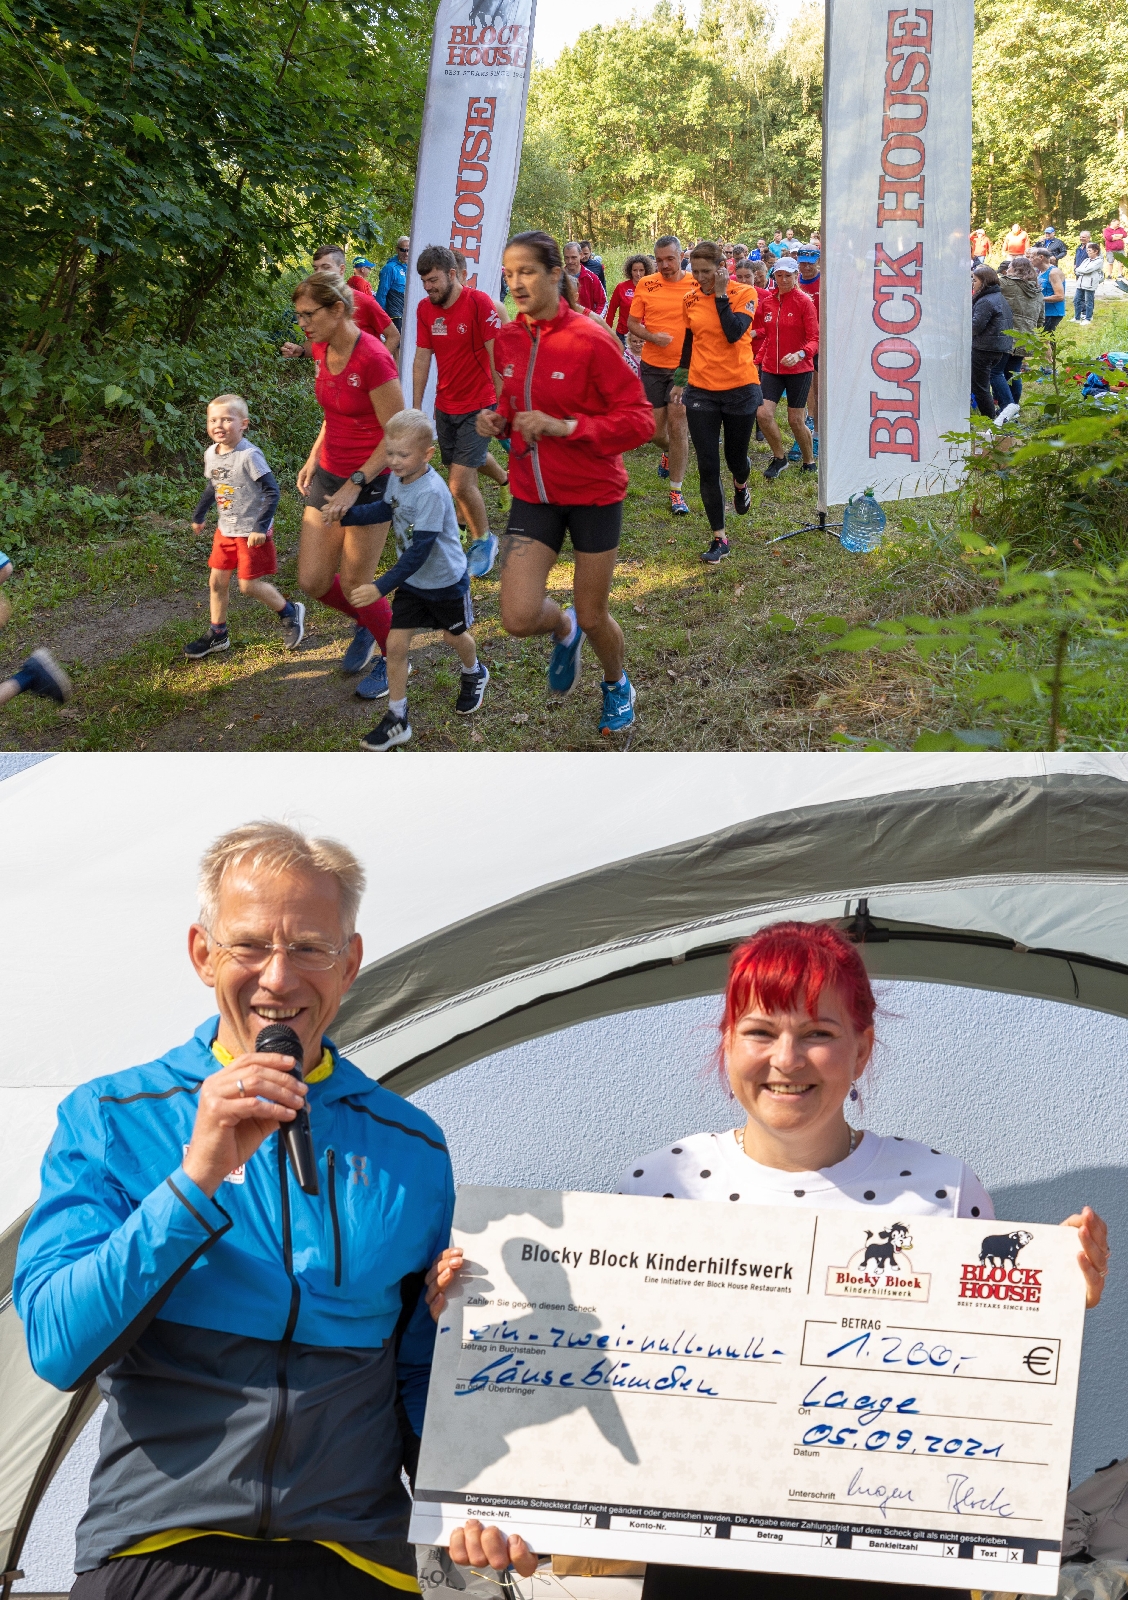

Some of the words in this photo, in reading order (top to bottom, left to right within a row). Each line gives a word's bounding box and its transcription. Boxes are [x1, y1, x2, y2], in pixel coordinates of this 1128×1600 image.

[448, 24, 529, 47] BLOCK
[446, 46, 527, 69] HOUSE
[876, 8, 933, 229] HOUSE
[450, 96, 497, 264] HOUSE
[868, 242, 924, 463] BLOCK
[521, 1244, 583, 1268] Blocky
[589, 1248, 639, 1269] Block
[646, 1252, 793, 1280] Kinderhilfswerk
[960, 1263, 1043, 1286] BLOCK
[644, 1275, 659, 1284] Eine
[660, 1277, 692, 1287] Initiative
[693, 1279, 705, 1288] der
[706, 1280, 726, 1289] Block
[727, 1282, 749, 1291] House
[750, 1283, 792, 1294] Restaurants
[844, 1286, 912, 1297] Kinderhilfswerk
[958, 1281, 1042, 1303] HOUSE
[467, 1296, 494, 1306] Zahlen
[496, 1298, 510, 1308] Sie
[511, 1300, 536, 1310] gegen
[538, 1302, 566, 1312] diesen
[567, 1303, 598, 1314] Scheck
[975, 1302, 1001, 1310] STEAKS
[841, 1317, 882, 1331] BETRAG
[460, 1341, 488, 1354] Betrag
[489, 1343, 497, 1353] in
[499, 1344, 547, 1356] Buchstaben
[1022, 1346, 1054, 1376] €
[455, 1382, 466, 1390] an
[488, 1382, 536, 1396] Überbringer
[797, 1406, 812, 1416] Ort
[793, 1447, 821, 1458] Datum
[788, 1488, 837, 1501] Unterschrift
[465, 1494, 480, 1504] Der
[480, 1496, 529, 1507] vorgedruckte
[530, 1499, 571, 1511] Schecktext
[572, 1502, 588, 1512] darf
[588, 1504, 607, 1513] nicht
[608, 1506, 642, 1516] geändert
[643, 1508, 661, 1518] oder
[662, 1510, 702, 1520] gestrichen
[702, 1513, 733, 1523] werden.
[734, 1515, 748, 1524] Die
[749, 1517, 779, 1527] Angabe
[779, 1519, 800, 1529] einer
[800, 1521, 850, 1533] Zahlungsfrist
[850, 1525, 865, 1534] auf
[865, 1526, 882, 1536] dem
[883, 1527, 912, 1538] Scheck
[912, 1530, 925, 1540] gilt
[926, 1532, 939, 1541] als
[939, 1533, 959, 1542] nicht
[959, 1535, 1009, 1547] geschrieben.
[466, 1508, 512, 1519] Scheck-NR.
[583, 1516, 592, 1527] X
[629, 1520, 667, 1531] Konto-Nr.
[703, 1526, 712, 1536] X
[756, 1531, 784, 1542] Betrag
[824, 1535, 833, 1546] X
[868, 1540, 919, 1552] Bankleitzahl
[946, 1546, 955, 1556] X
[980, 1549, 998, 1559] Text
[1010, 1551, 1019, 1561] X
